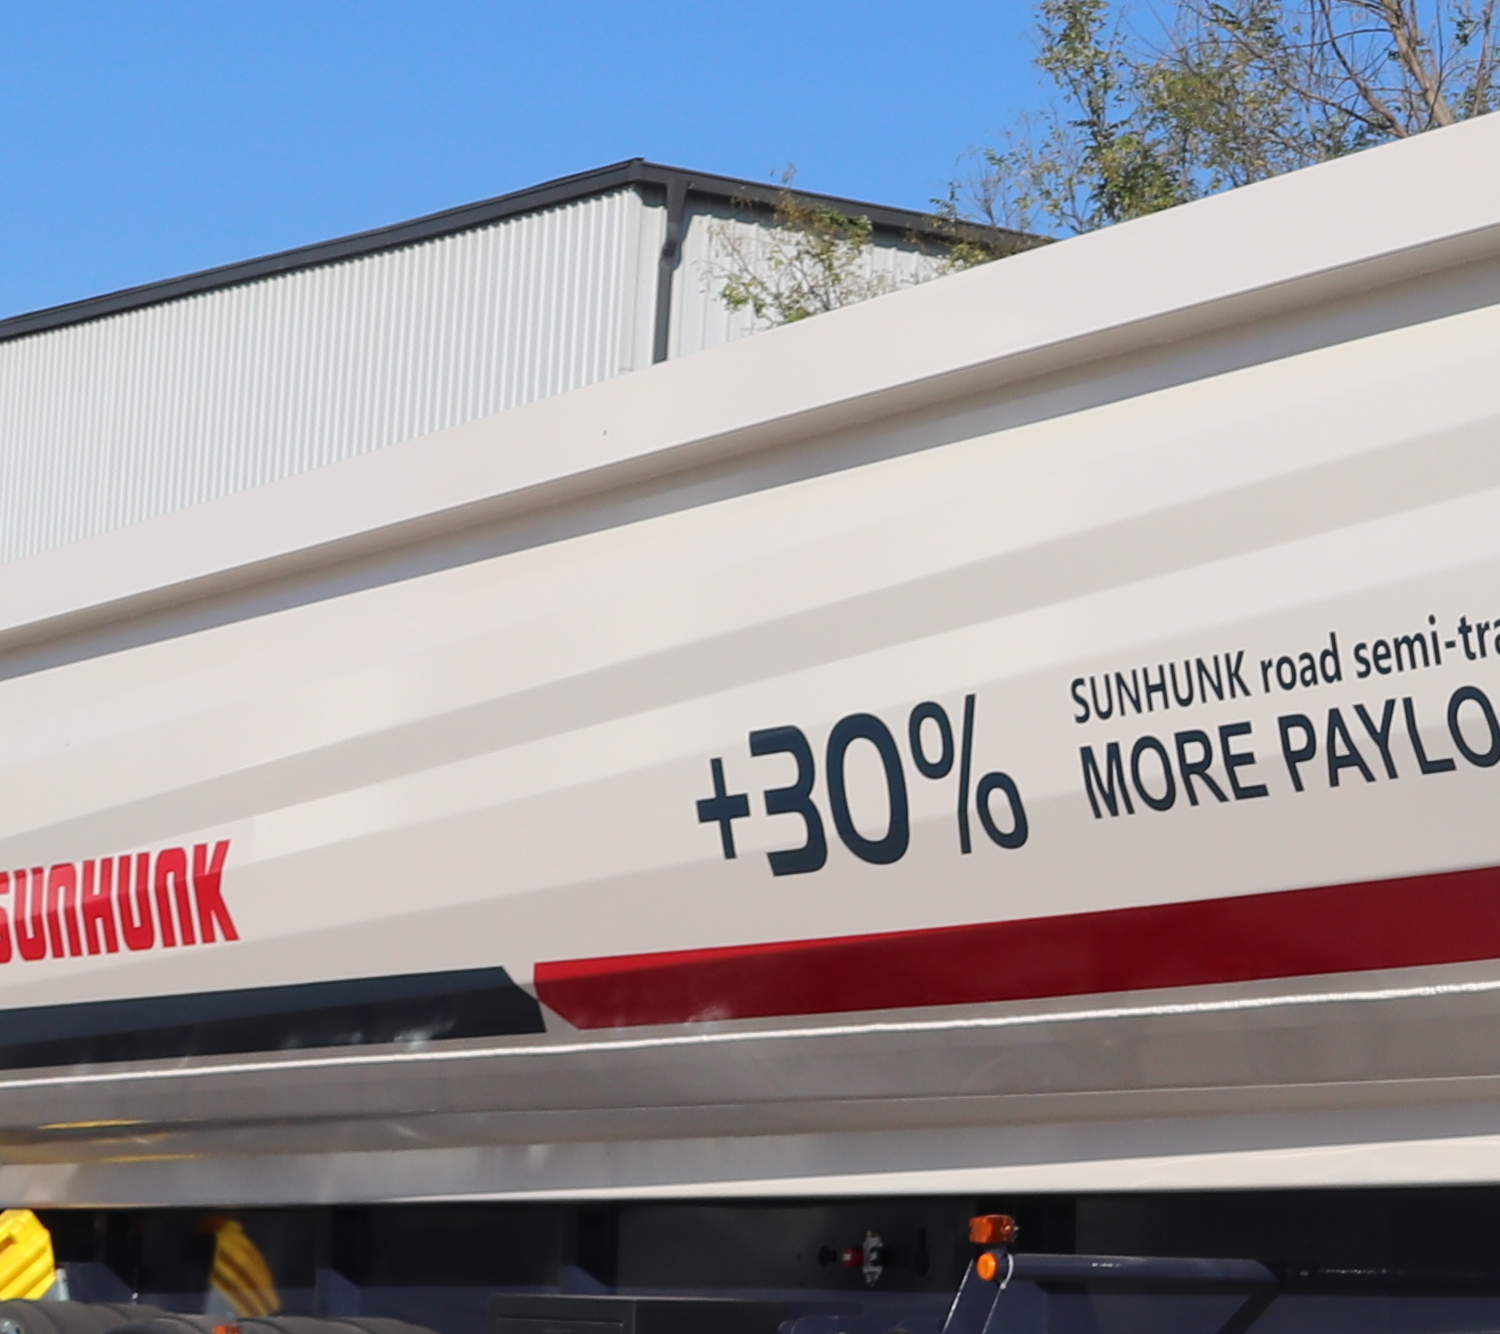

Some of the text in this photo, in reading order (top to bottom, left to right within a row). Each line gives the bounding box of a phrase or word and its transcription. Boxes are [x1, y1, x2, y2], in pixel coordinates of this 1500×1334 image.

[1070, 651, 1251, 724] SUNHUNK
[1260, 632, 1343, 694] road
[695, 693, 1029, 877] +30%
[1079, 720, 1270, 820] MORE
